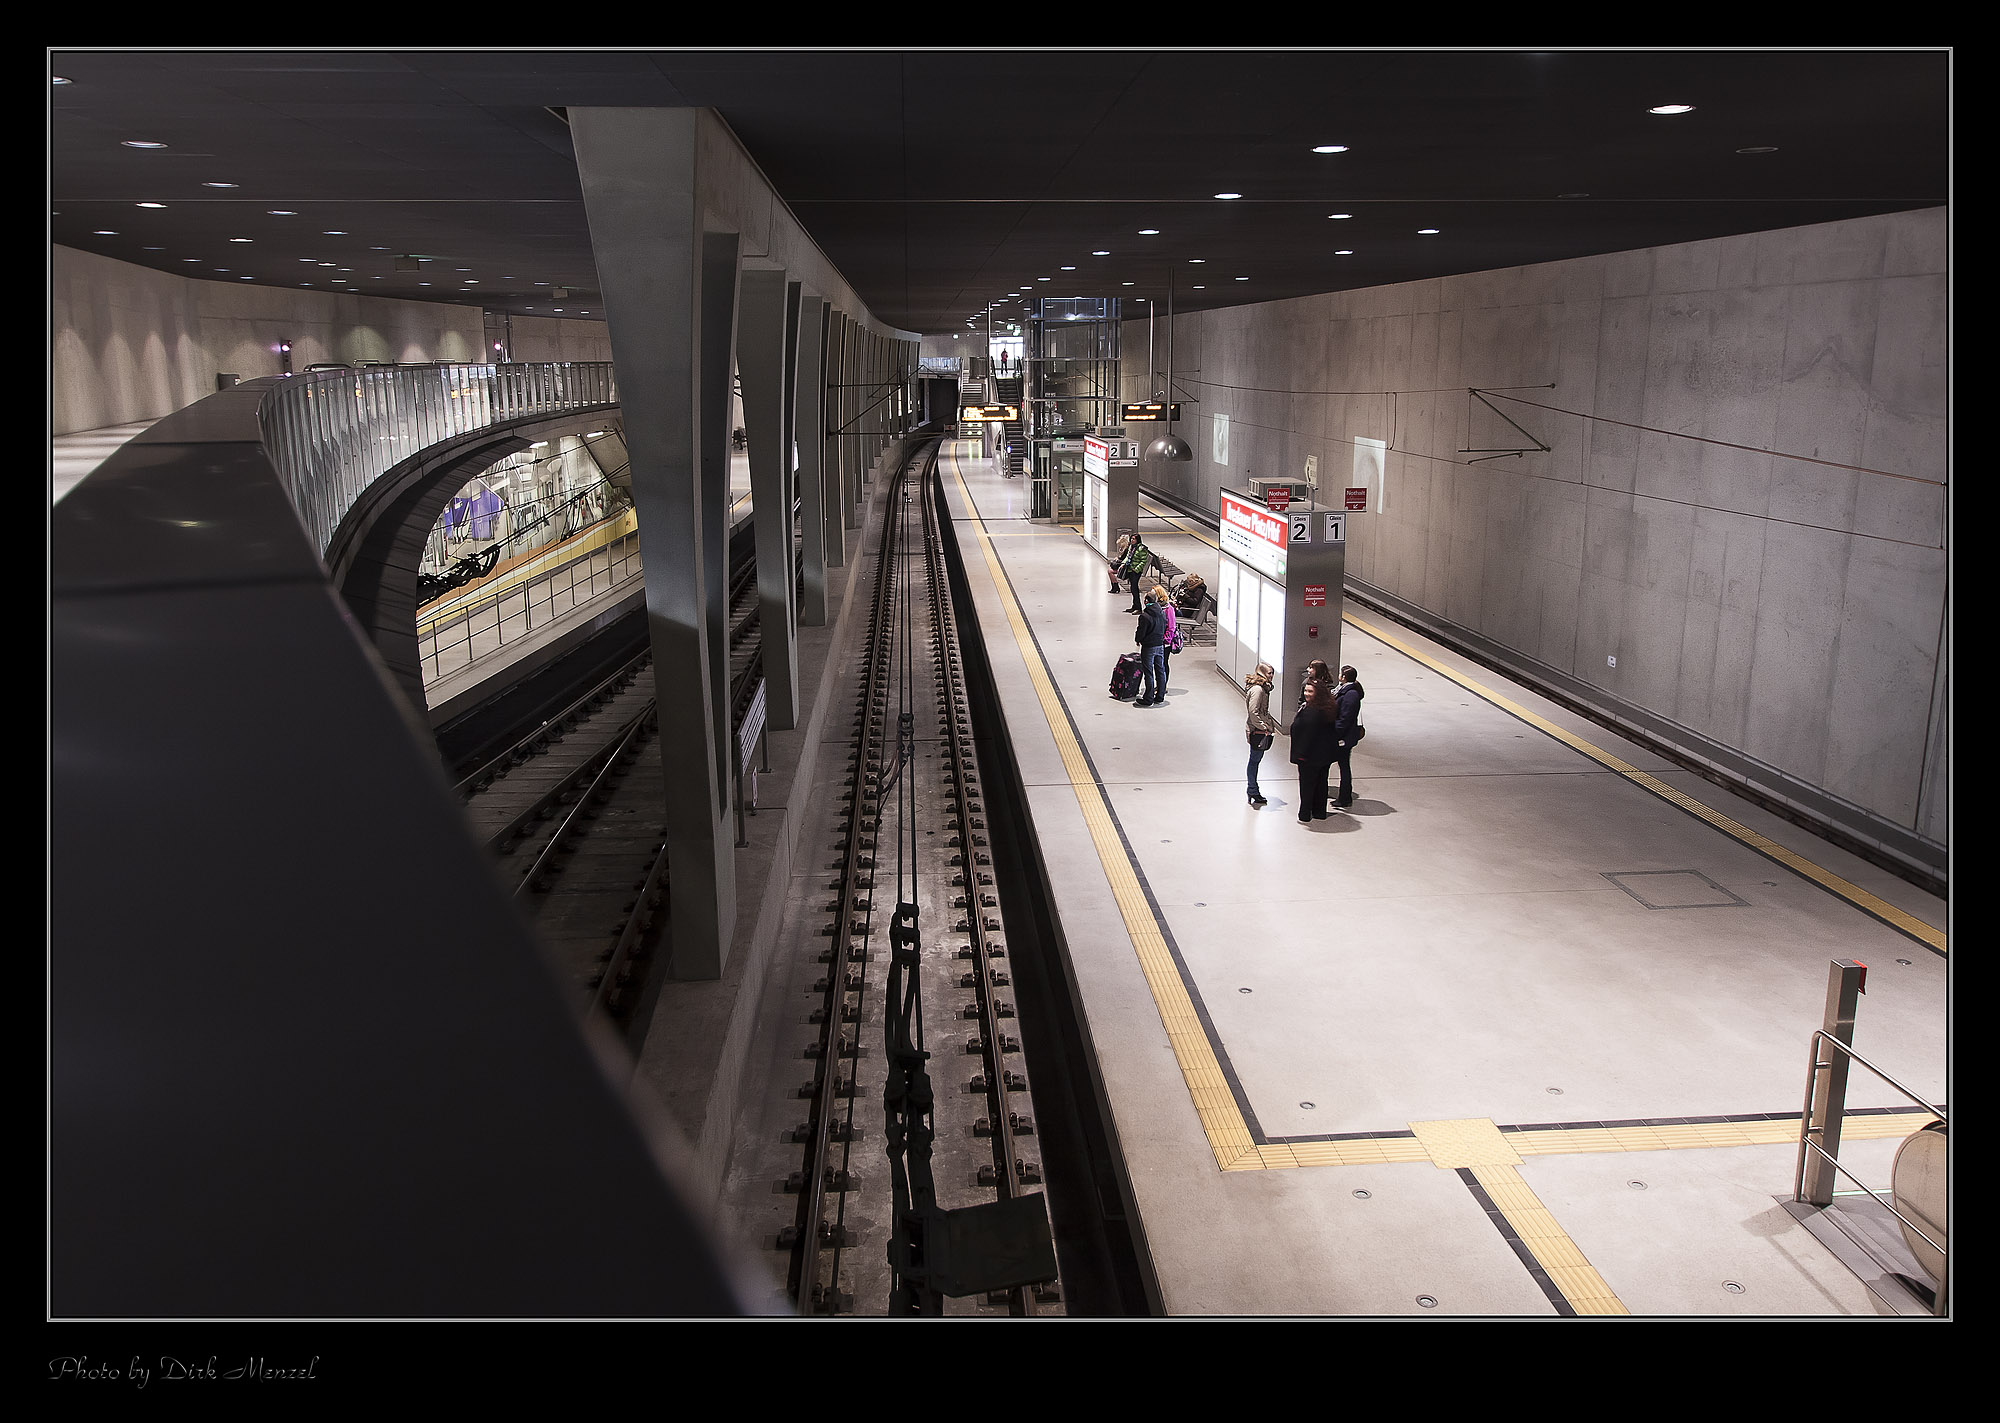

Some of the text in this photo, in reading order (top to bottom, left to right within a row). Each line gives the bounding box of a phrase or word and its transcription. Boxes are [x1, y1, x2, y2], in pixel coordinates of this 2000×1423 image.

[1110, 447, 1118, 457] 2
[1130, 446, 1136, 457] 1
[1293, 523, 1306, 541] 2
[1330, 522, 1339, 540] 1
